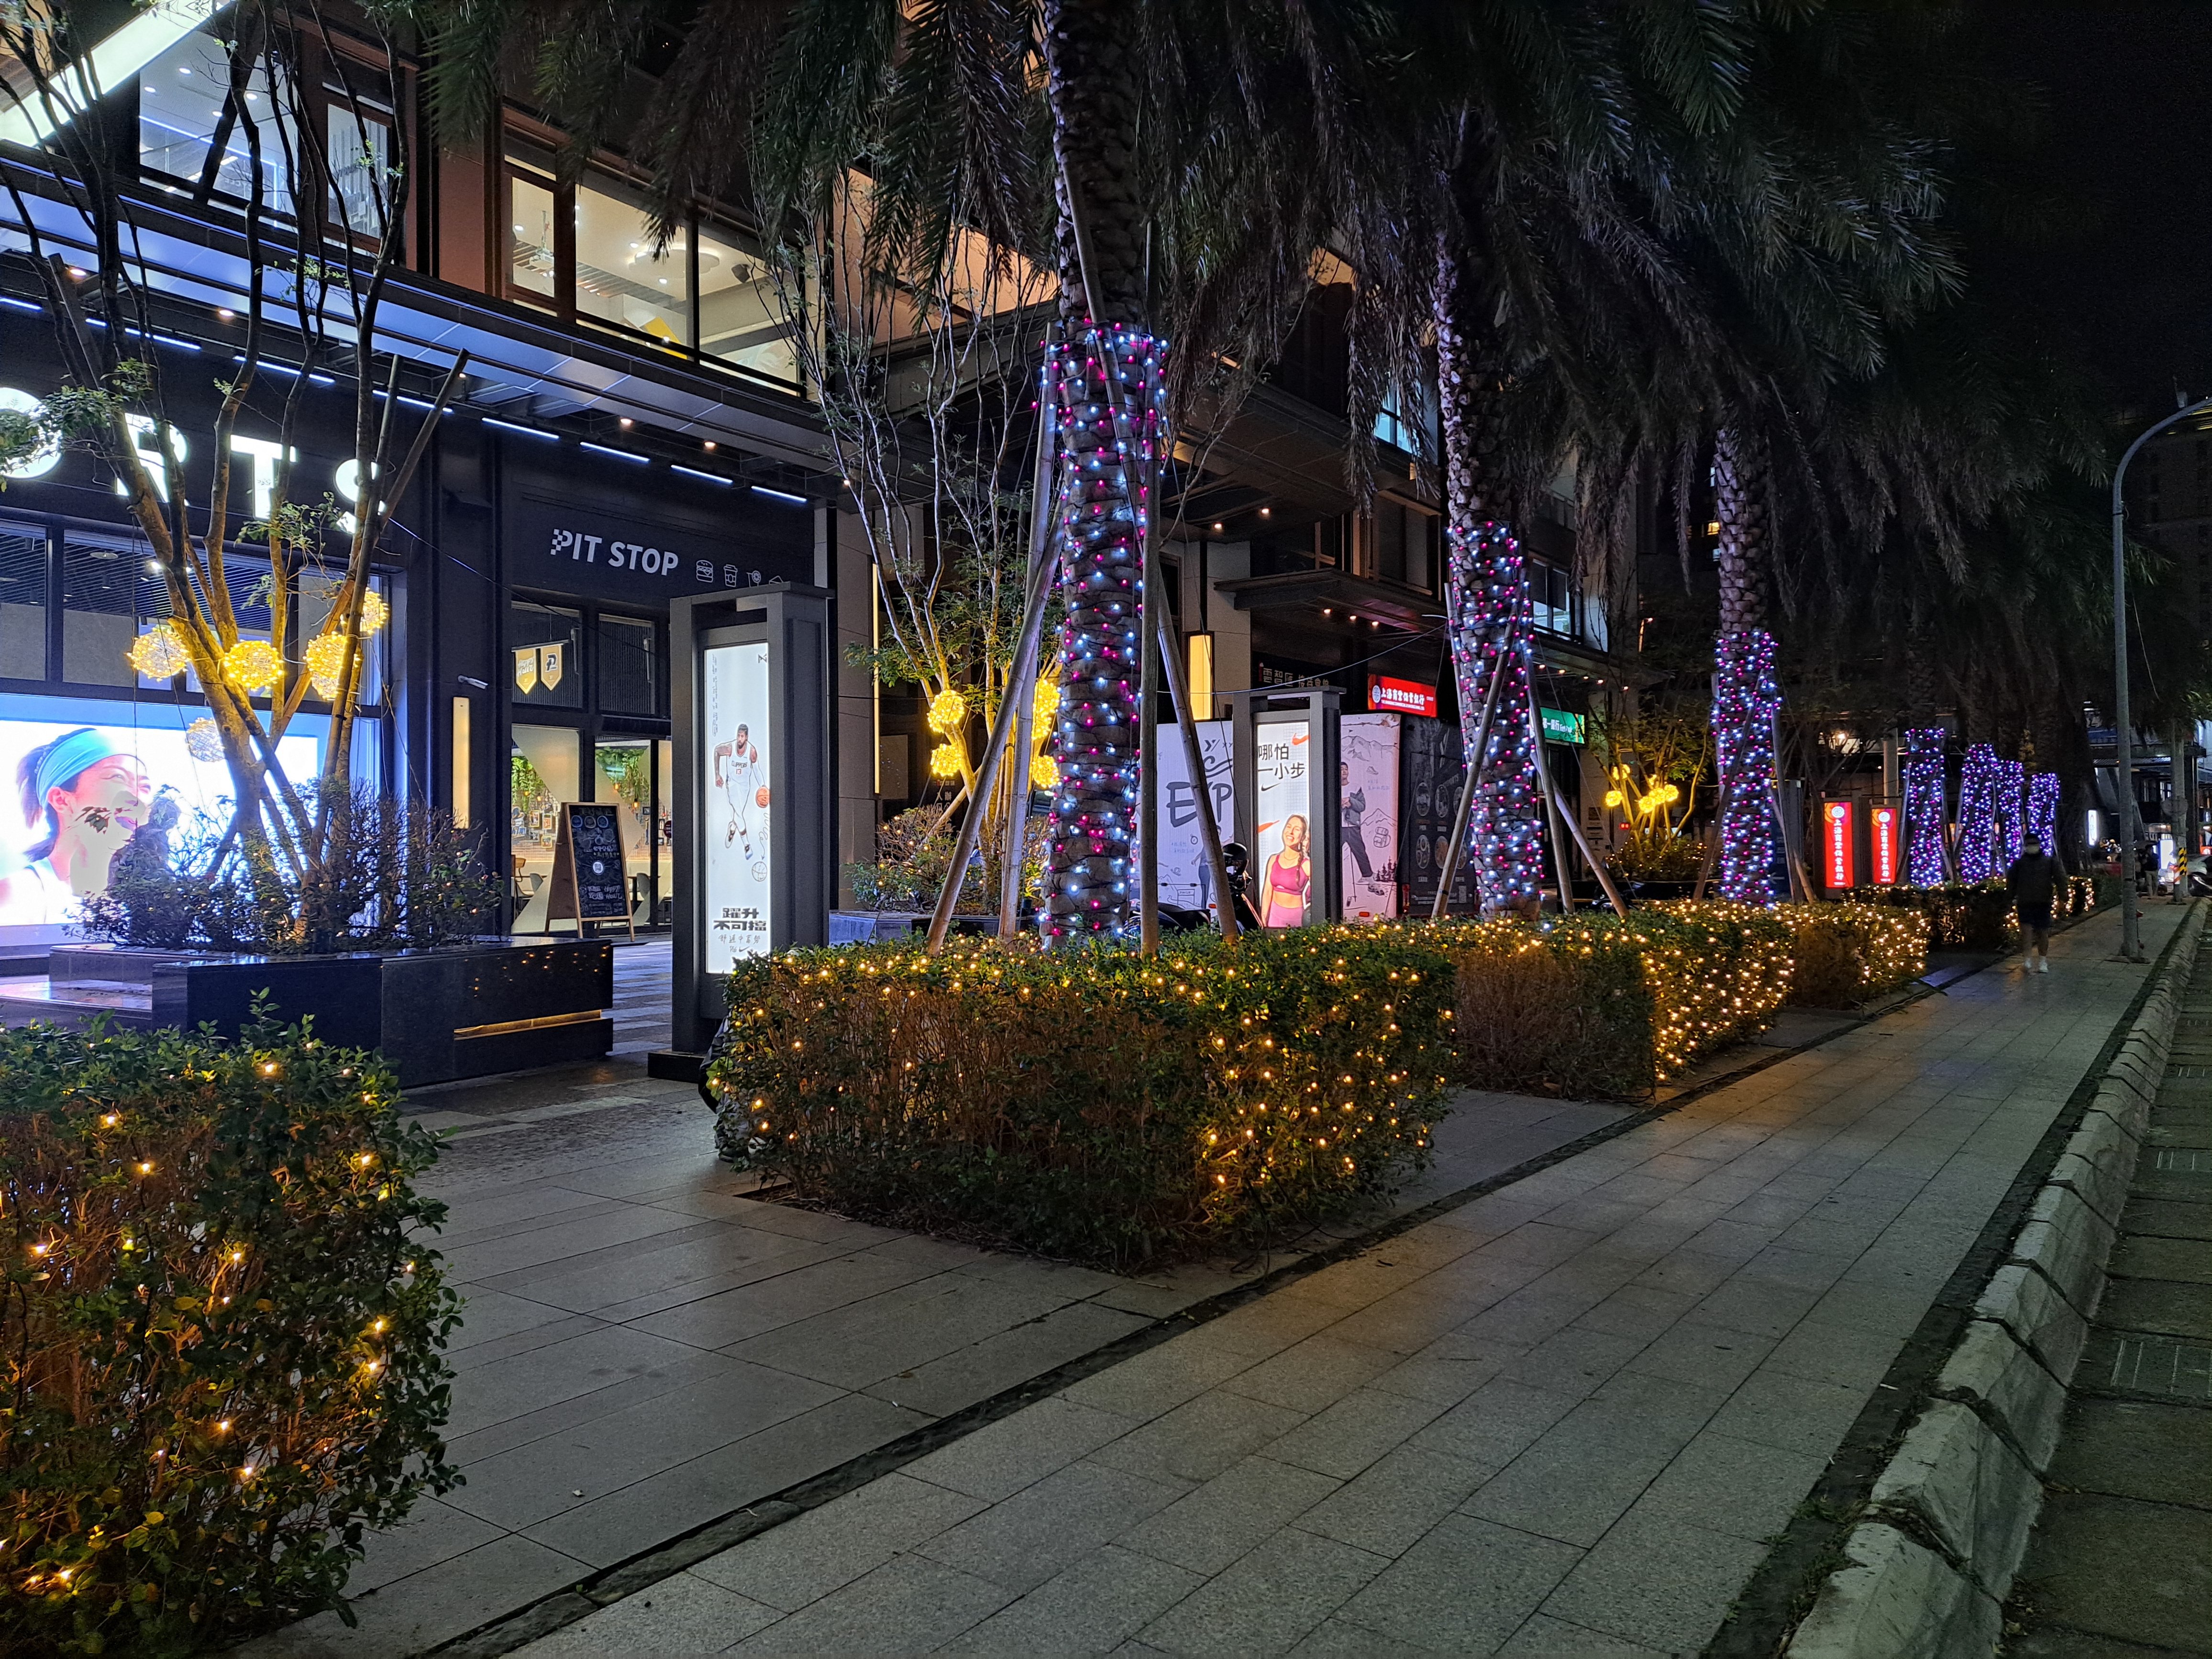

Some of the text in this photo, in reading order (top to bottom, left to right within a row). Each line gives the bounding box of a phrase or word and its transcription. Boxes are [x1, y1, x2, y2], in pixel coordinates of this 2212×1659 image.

[551, 529, 678, 575] PIT STOP
[1258, 743, 1289, 761] 哪怕
[1258, 762, 1305, 780] 一小步
[722, 907, 759, 918] 躍升
[713, 920, 766, 931] 不可擋
